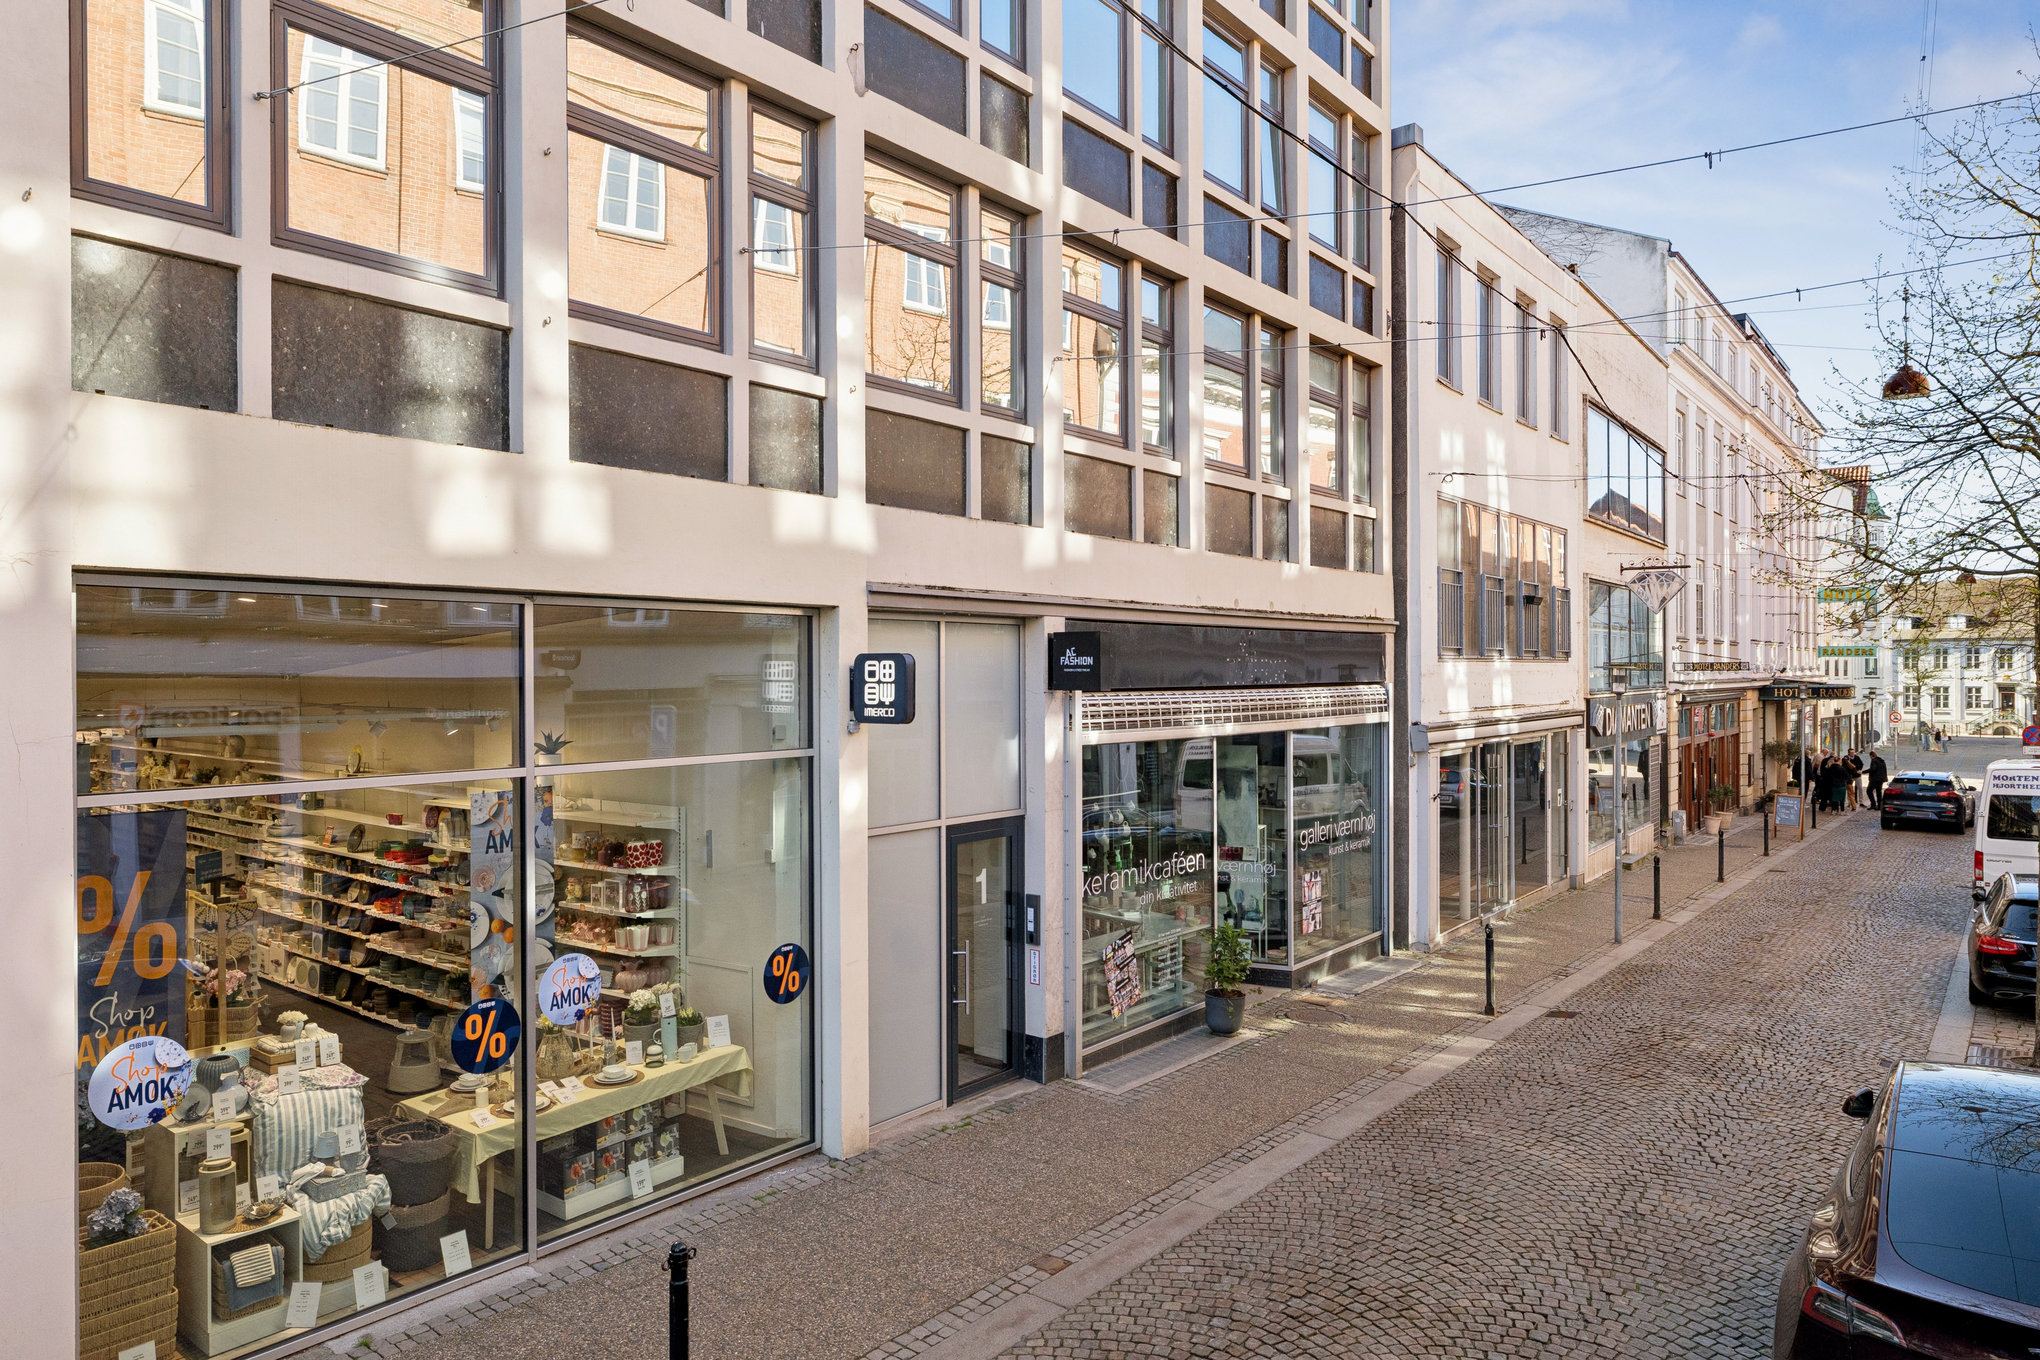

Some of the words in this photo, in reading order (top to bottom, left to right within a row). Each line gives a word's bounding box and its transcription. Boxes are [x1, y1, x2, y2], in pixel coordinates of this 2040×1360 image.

[1060, 656, 1094, 665] FASHION
[1066, 647, 1076, 657] AC
[1713, 662, 1740, 671] RANDERS
[1822, 648, 1875, 656] RANDERS
[1774, 688, 1817, 697] HOTL
[864, 707, 895, 717] IMERCO
[1606, 703, 1651, 736] DIMANTEN
[1301, 818, 1332, 852] galleri
[1334, 809, 1376, 838] værnhøj
[1329, 844, 1344, 856] kunst
[1345, 841, 1349, 852] &
[1350, 836, 1371, 851] keramik
[975, 868, 987, 905] 1
[1081, 851, 1206, 898] keramikcaféen
[551, 964, 587, 1001] Shop
[549, 984, 592, 1012] AMOK
[90, 991, 155, 1039] Shop
[111, 1050, 168, 1098] Shop
[107, 1075, 176, 1114] AMOK
